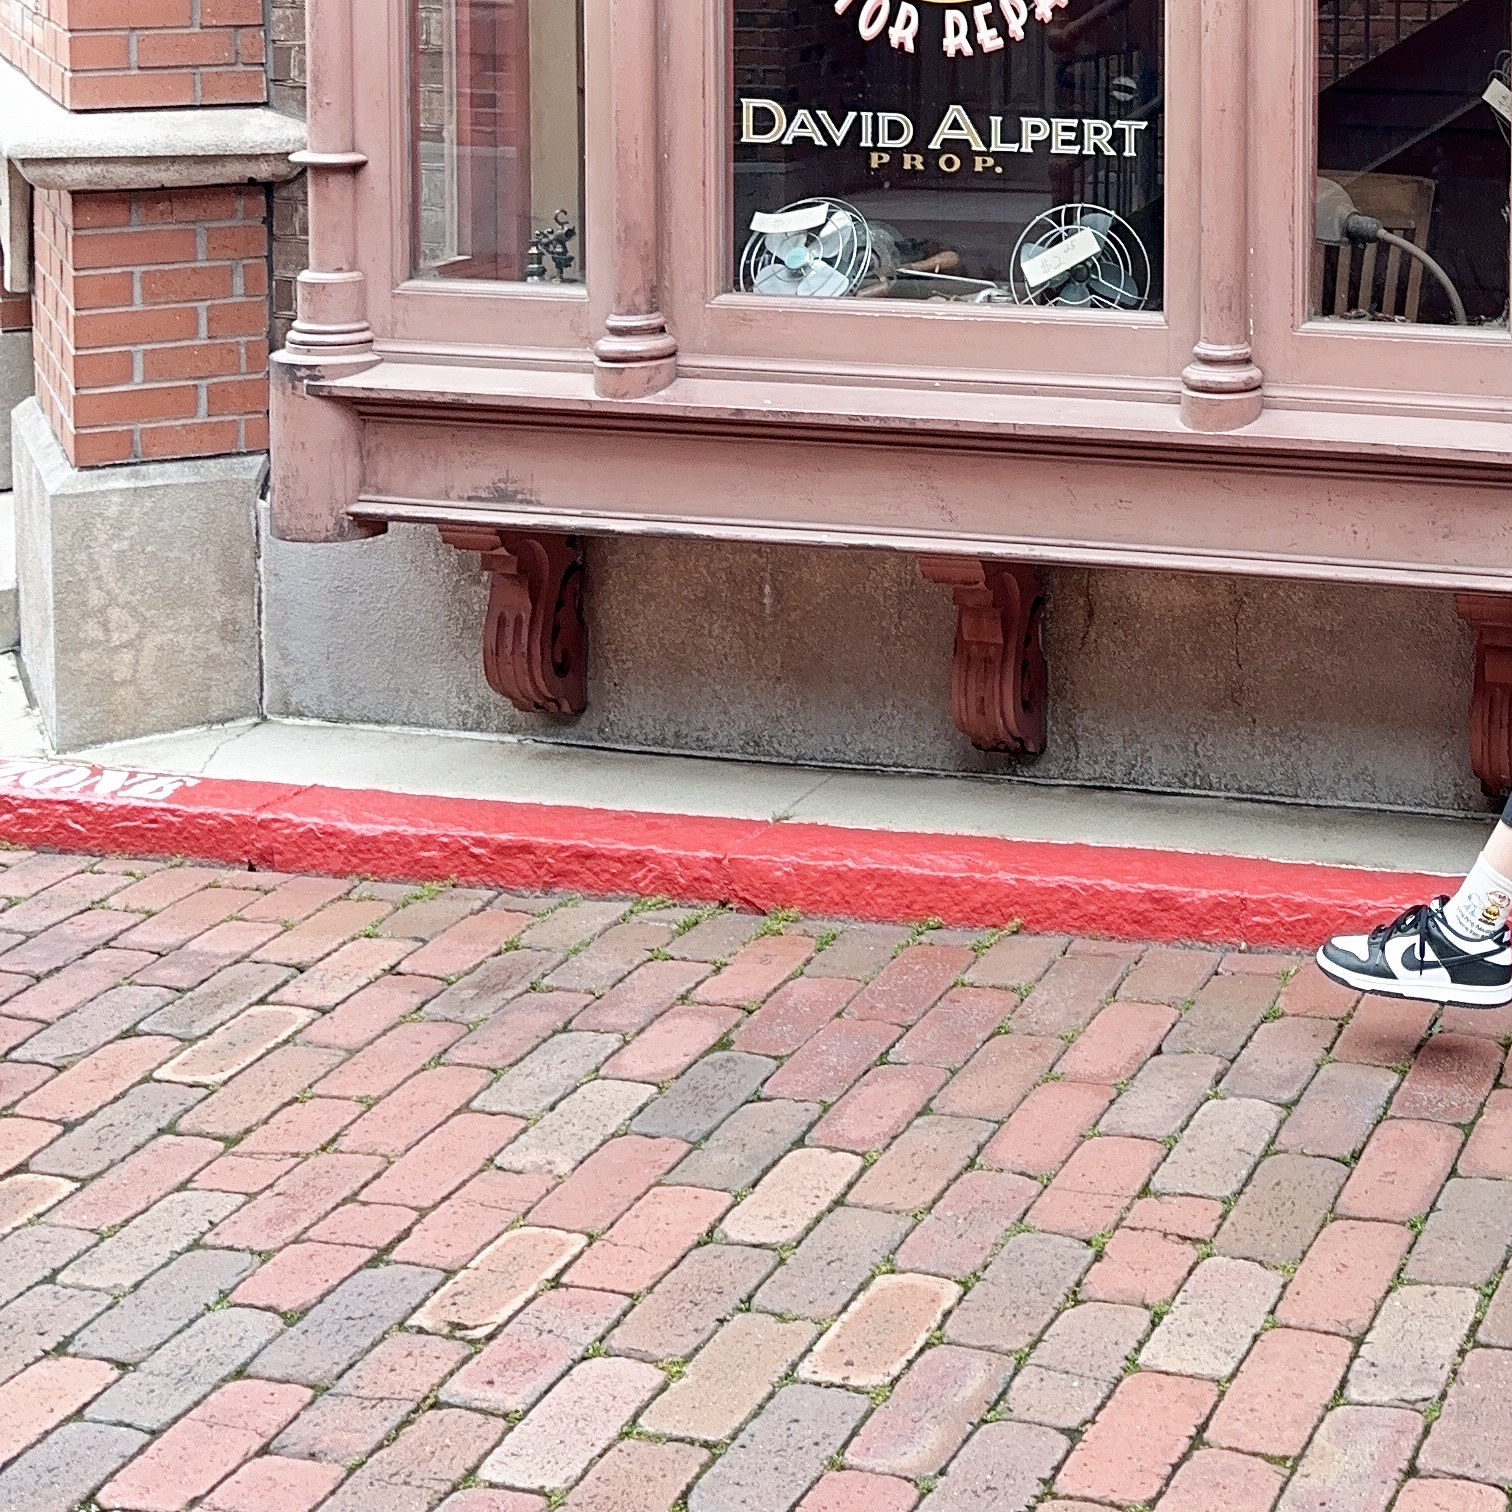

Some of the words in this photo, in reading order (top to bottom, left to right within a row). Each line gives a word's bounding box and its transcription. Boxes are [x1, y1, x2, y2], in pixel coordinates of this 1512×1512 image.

[740, 98, 914, 148] DAVID
[928, 105, 1148, 157] ALPERT
[869, 152, 1003, 174] PROP.
